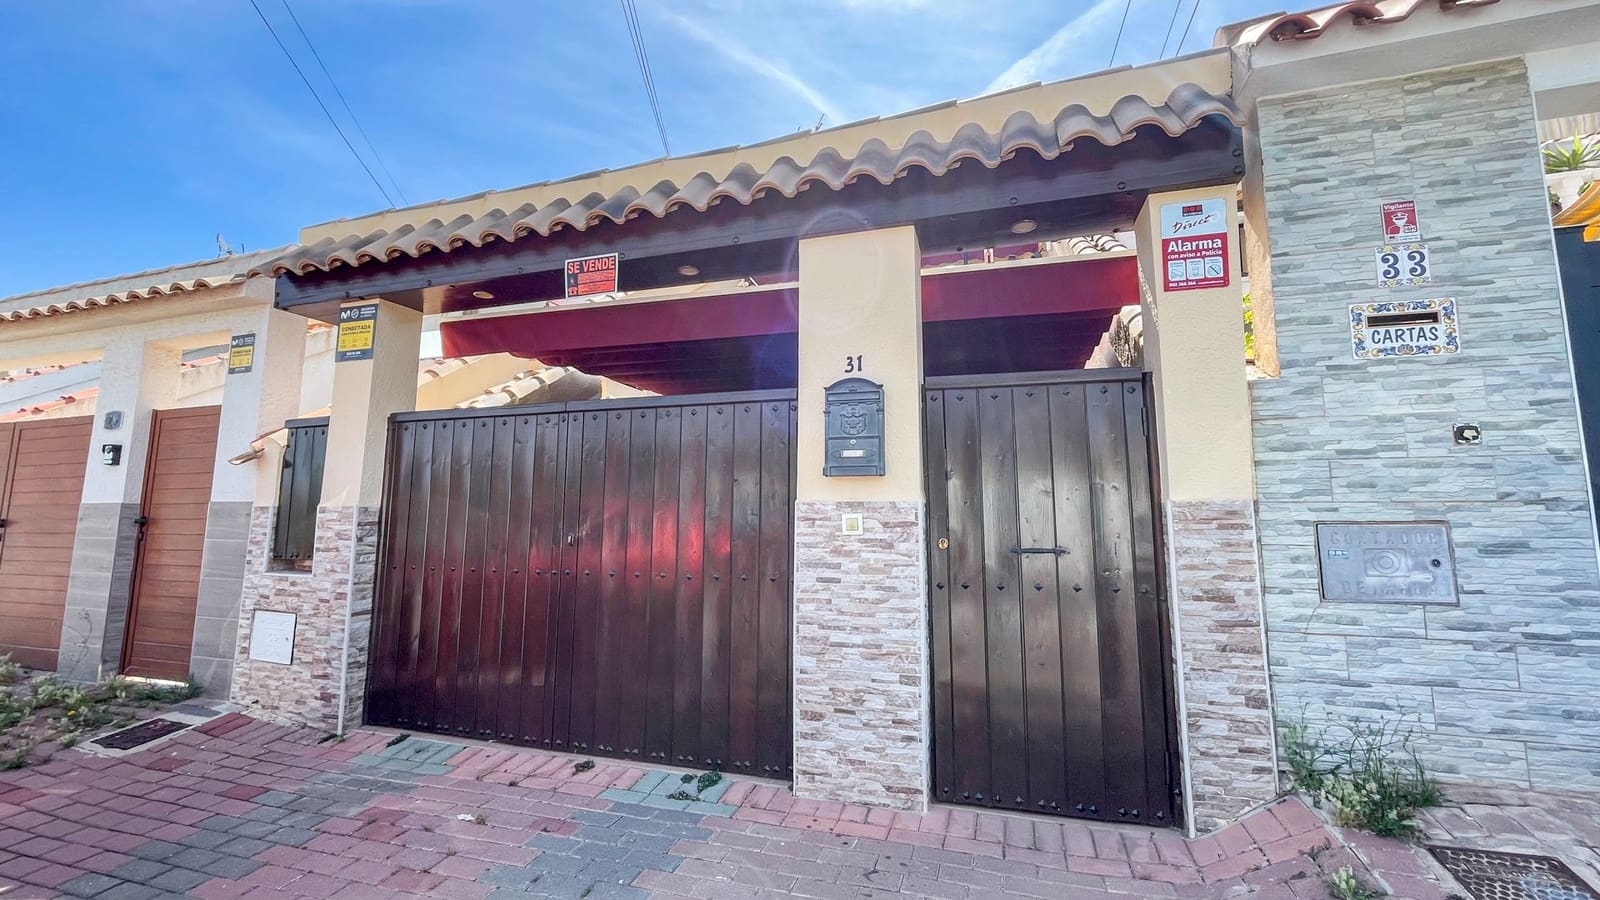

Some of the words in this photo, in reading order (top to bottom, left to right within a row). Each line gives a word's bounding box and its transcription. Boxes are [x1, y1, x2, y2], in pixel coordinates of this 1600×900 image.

[1168, 239, 1222, 253] Alarma
[568, 262, 580, 274] SE
[582, 257, 615, 272] VENDE
[1381, 251, 1426, 279] 33
[1371, 326, 1439, 345] CARTAS
[844, 355, 863, 373] 31
